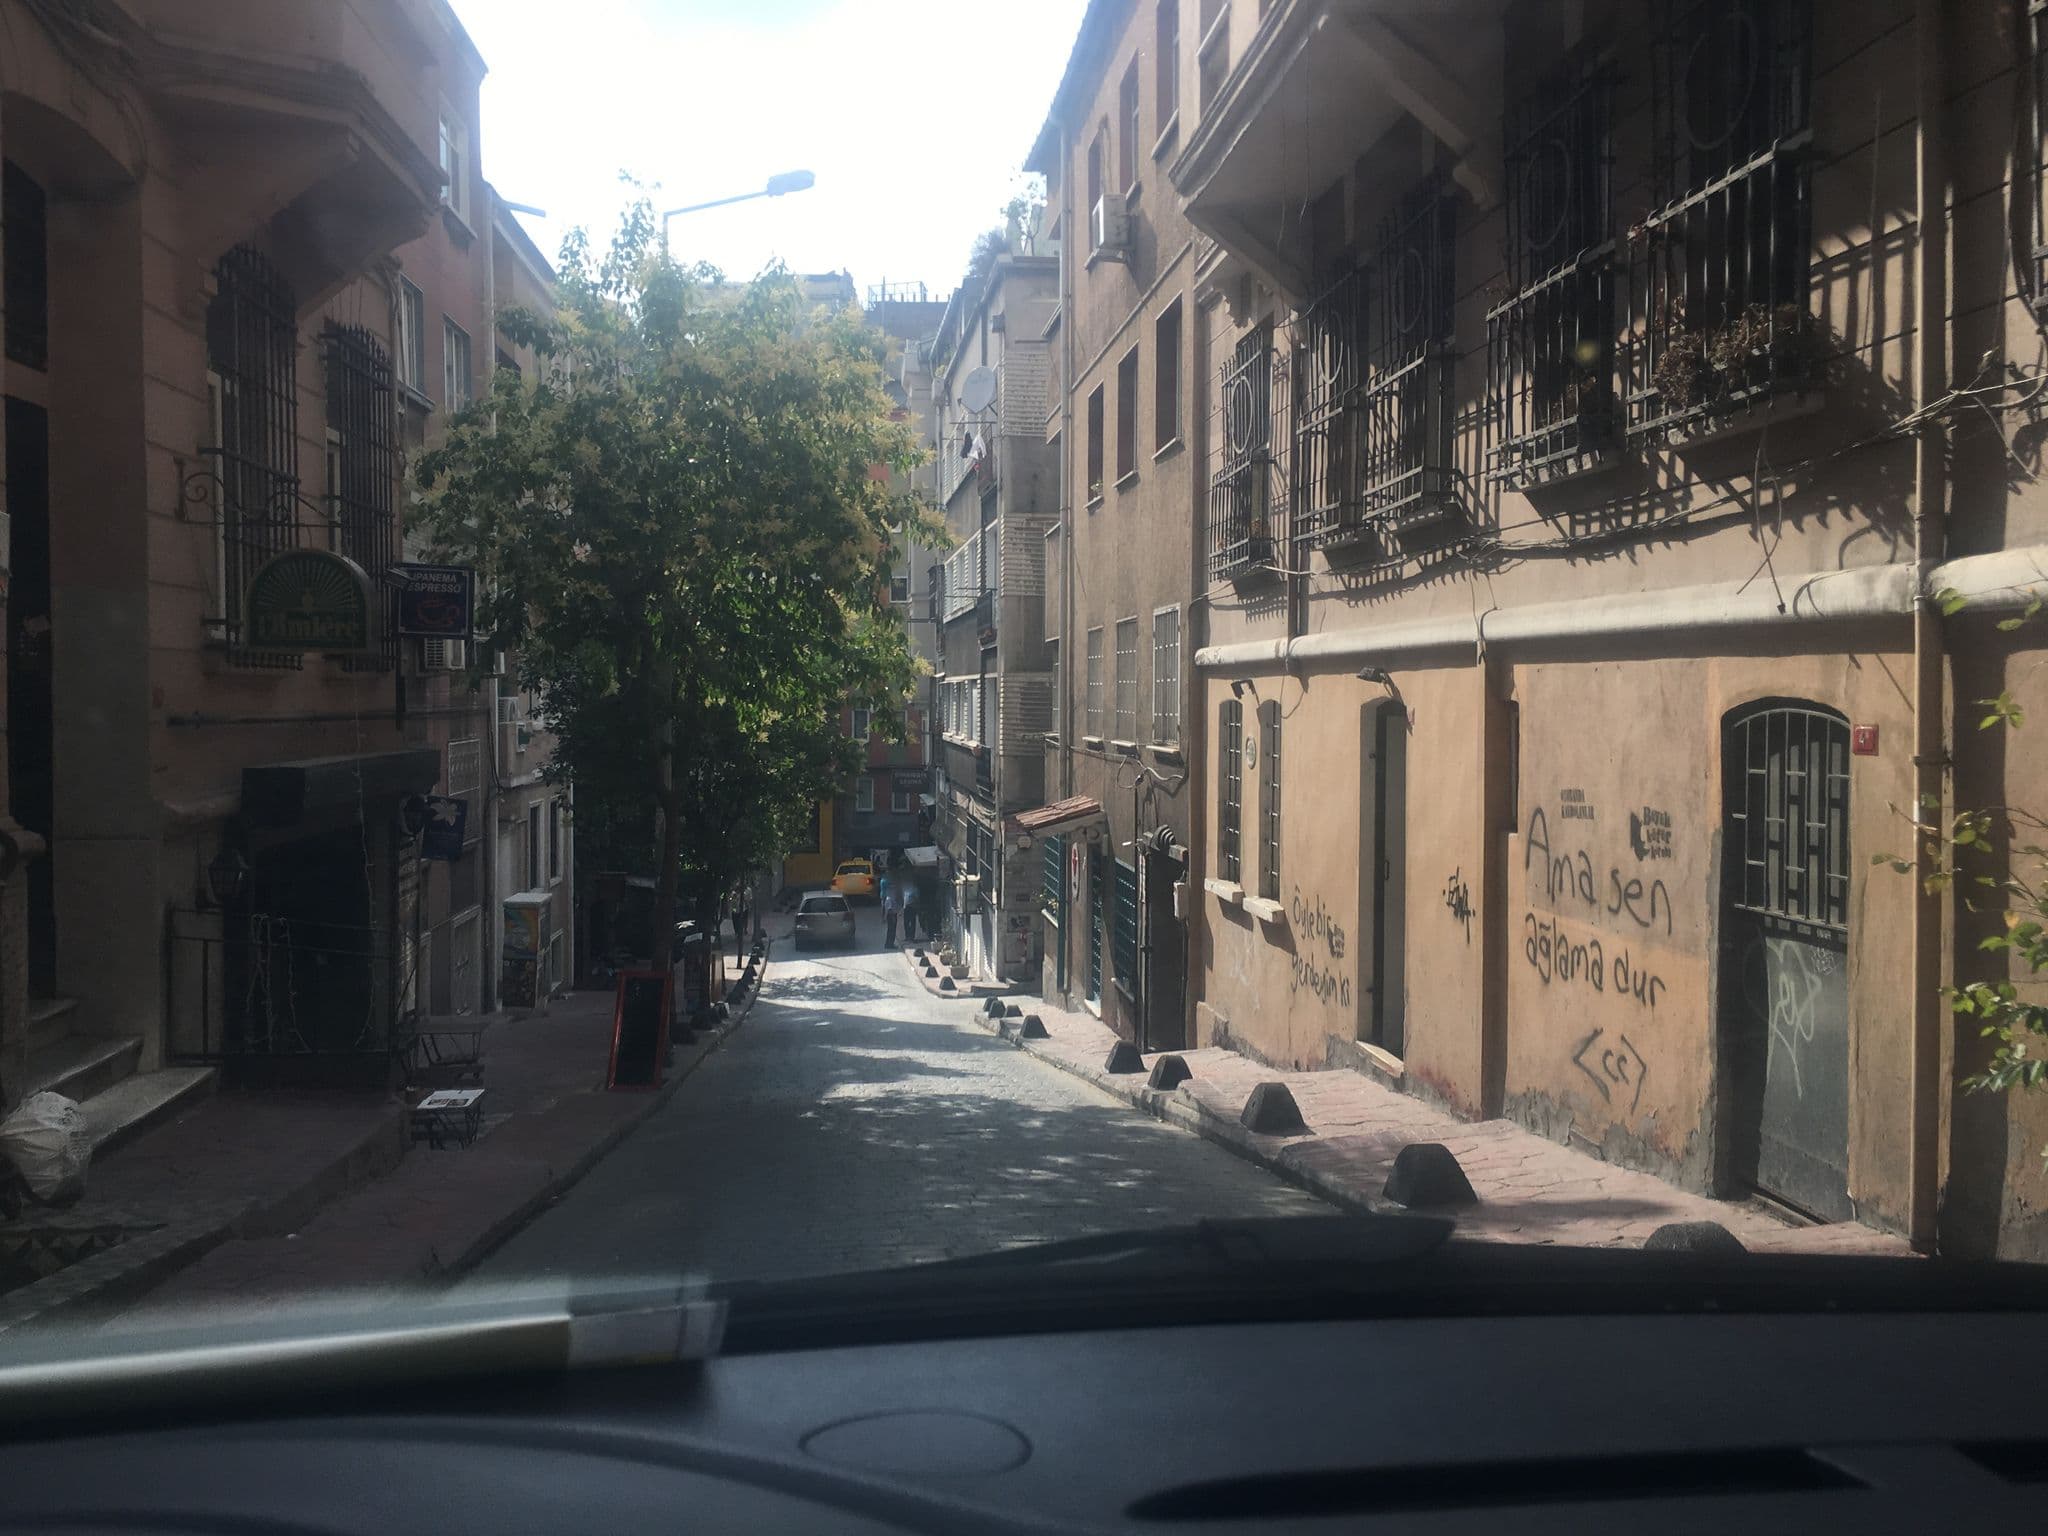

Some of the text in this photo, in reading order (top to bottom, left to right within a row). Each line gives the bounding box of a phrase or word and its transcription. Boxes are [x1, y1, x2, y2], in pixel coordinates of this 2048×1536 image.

[408, 582, 461, 593] ESPRESSO
[1525, 807, 1672, 936] Ama sen
[1525, 912, 1667, 1009] ağlama dur
